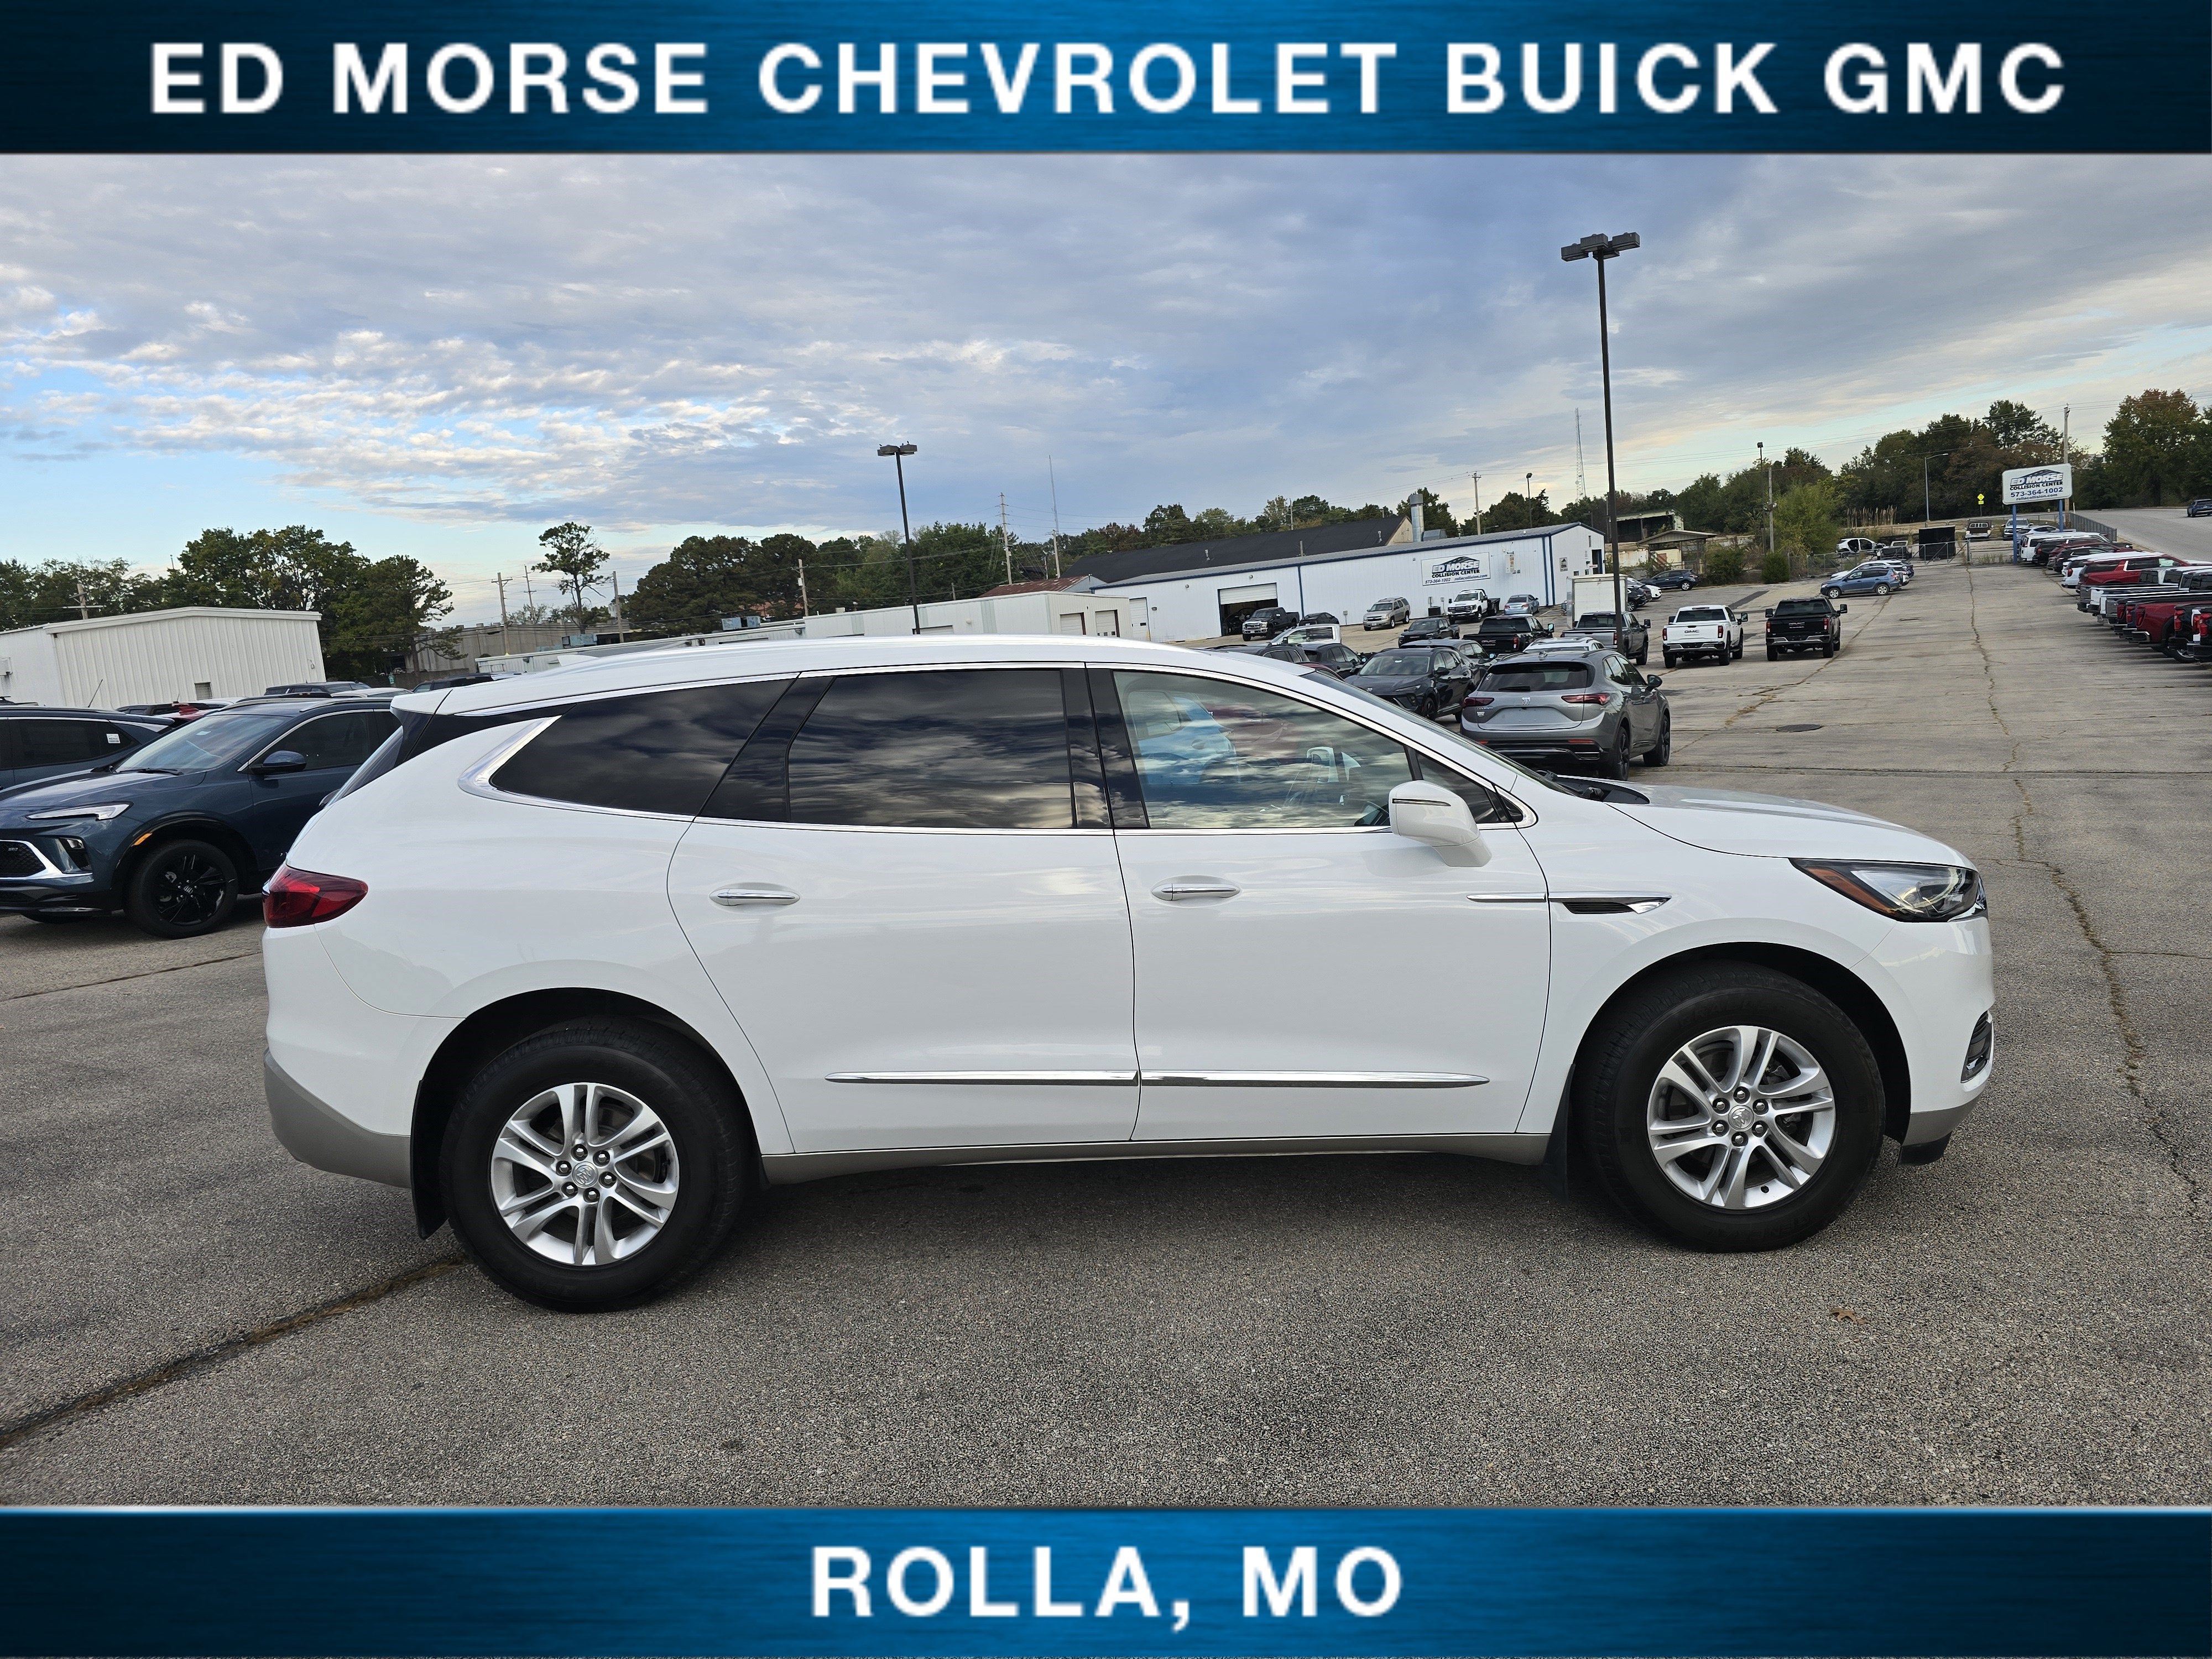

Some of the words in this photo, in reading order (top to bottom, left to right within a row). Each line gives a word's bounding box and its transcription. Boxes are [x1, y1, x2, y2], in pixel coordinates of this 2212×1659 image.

[2026, 472, 2063, 484] MORSE
[2011, 487, 2063, 497] 573-364-1002
[1446, 561, 1479, 571] MORSE
